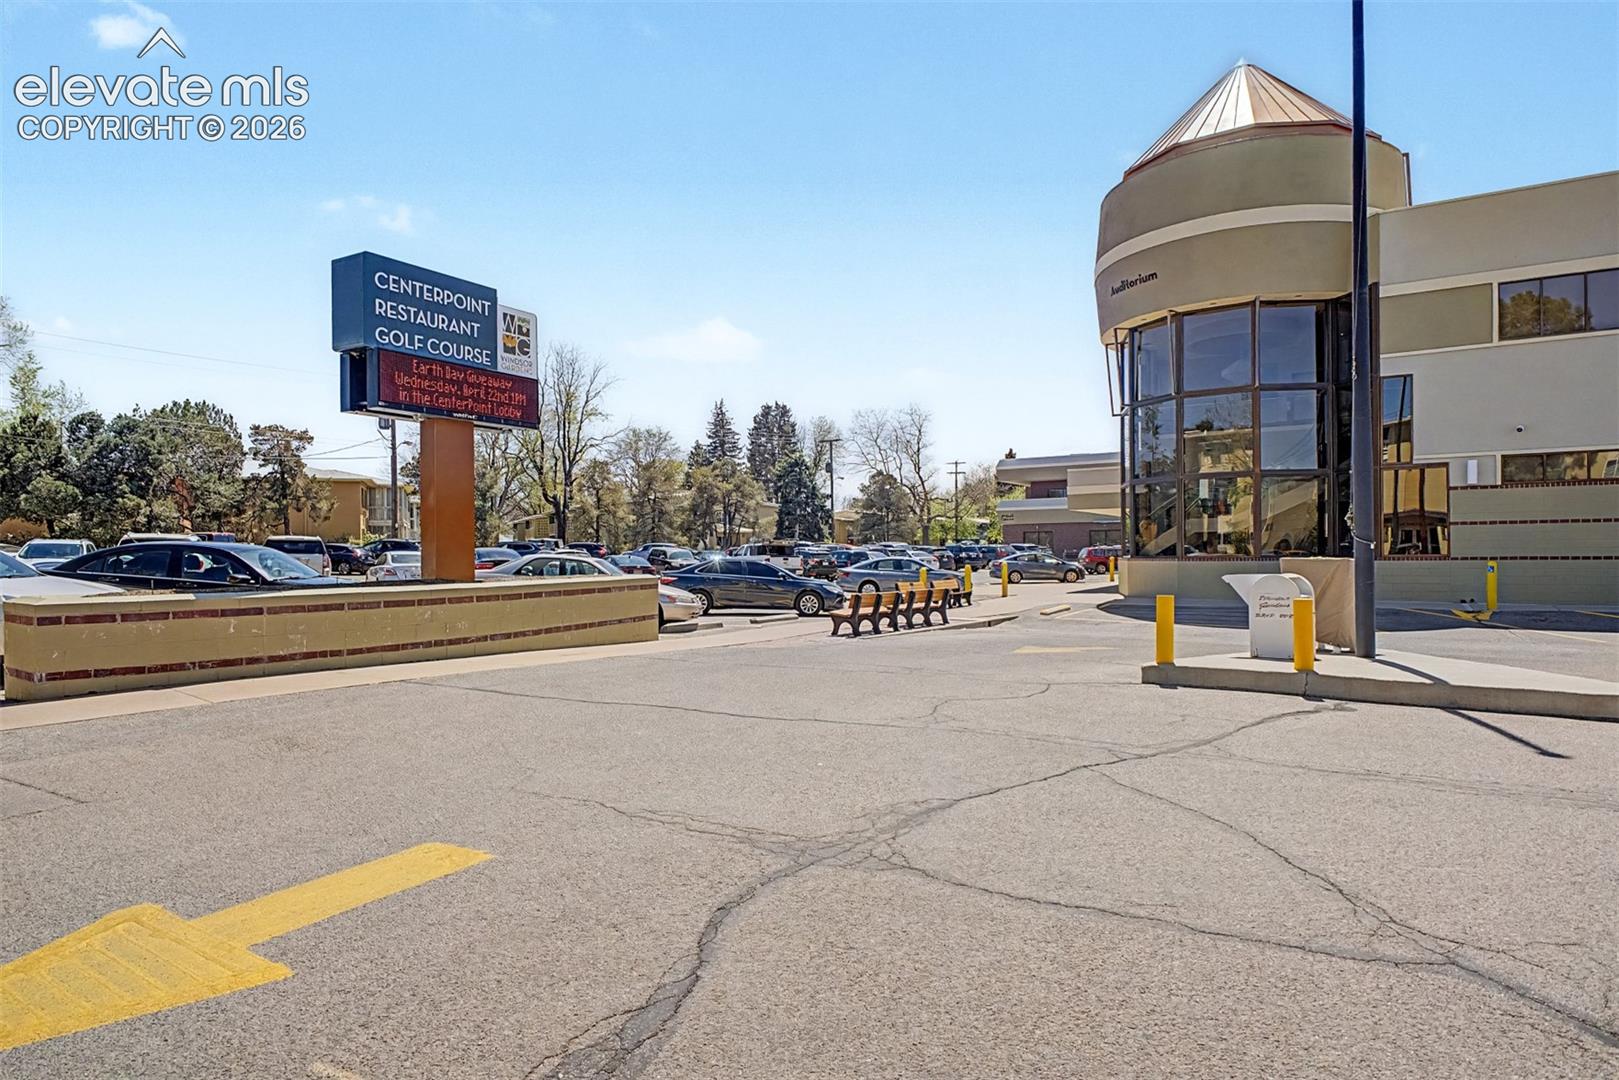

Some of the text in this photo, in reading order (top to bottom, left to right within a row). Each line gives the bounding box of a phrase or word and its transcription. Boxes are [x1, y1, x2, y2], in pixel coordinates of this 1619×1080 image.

[374, 271, 492, 317] CENTERPOINT
[1110, 272, 1158, 297] Auditorium
[375, 298, 481, 338] RESTAURANT
[375, 326, 492, 366] GOLF COURSE
[412, 359, 443, 379] Earth
[445, 365, 465, 381] Day
[412, 389, 431, 405] the
[493, 403, 522, 419] Lobby
[488, 389, 509, 404] 22nd
